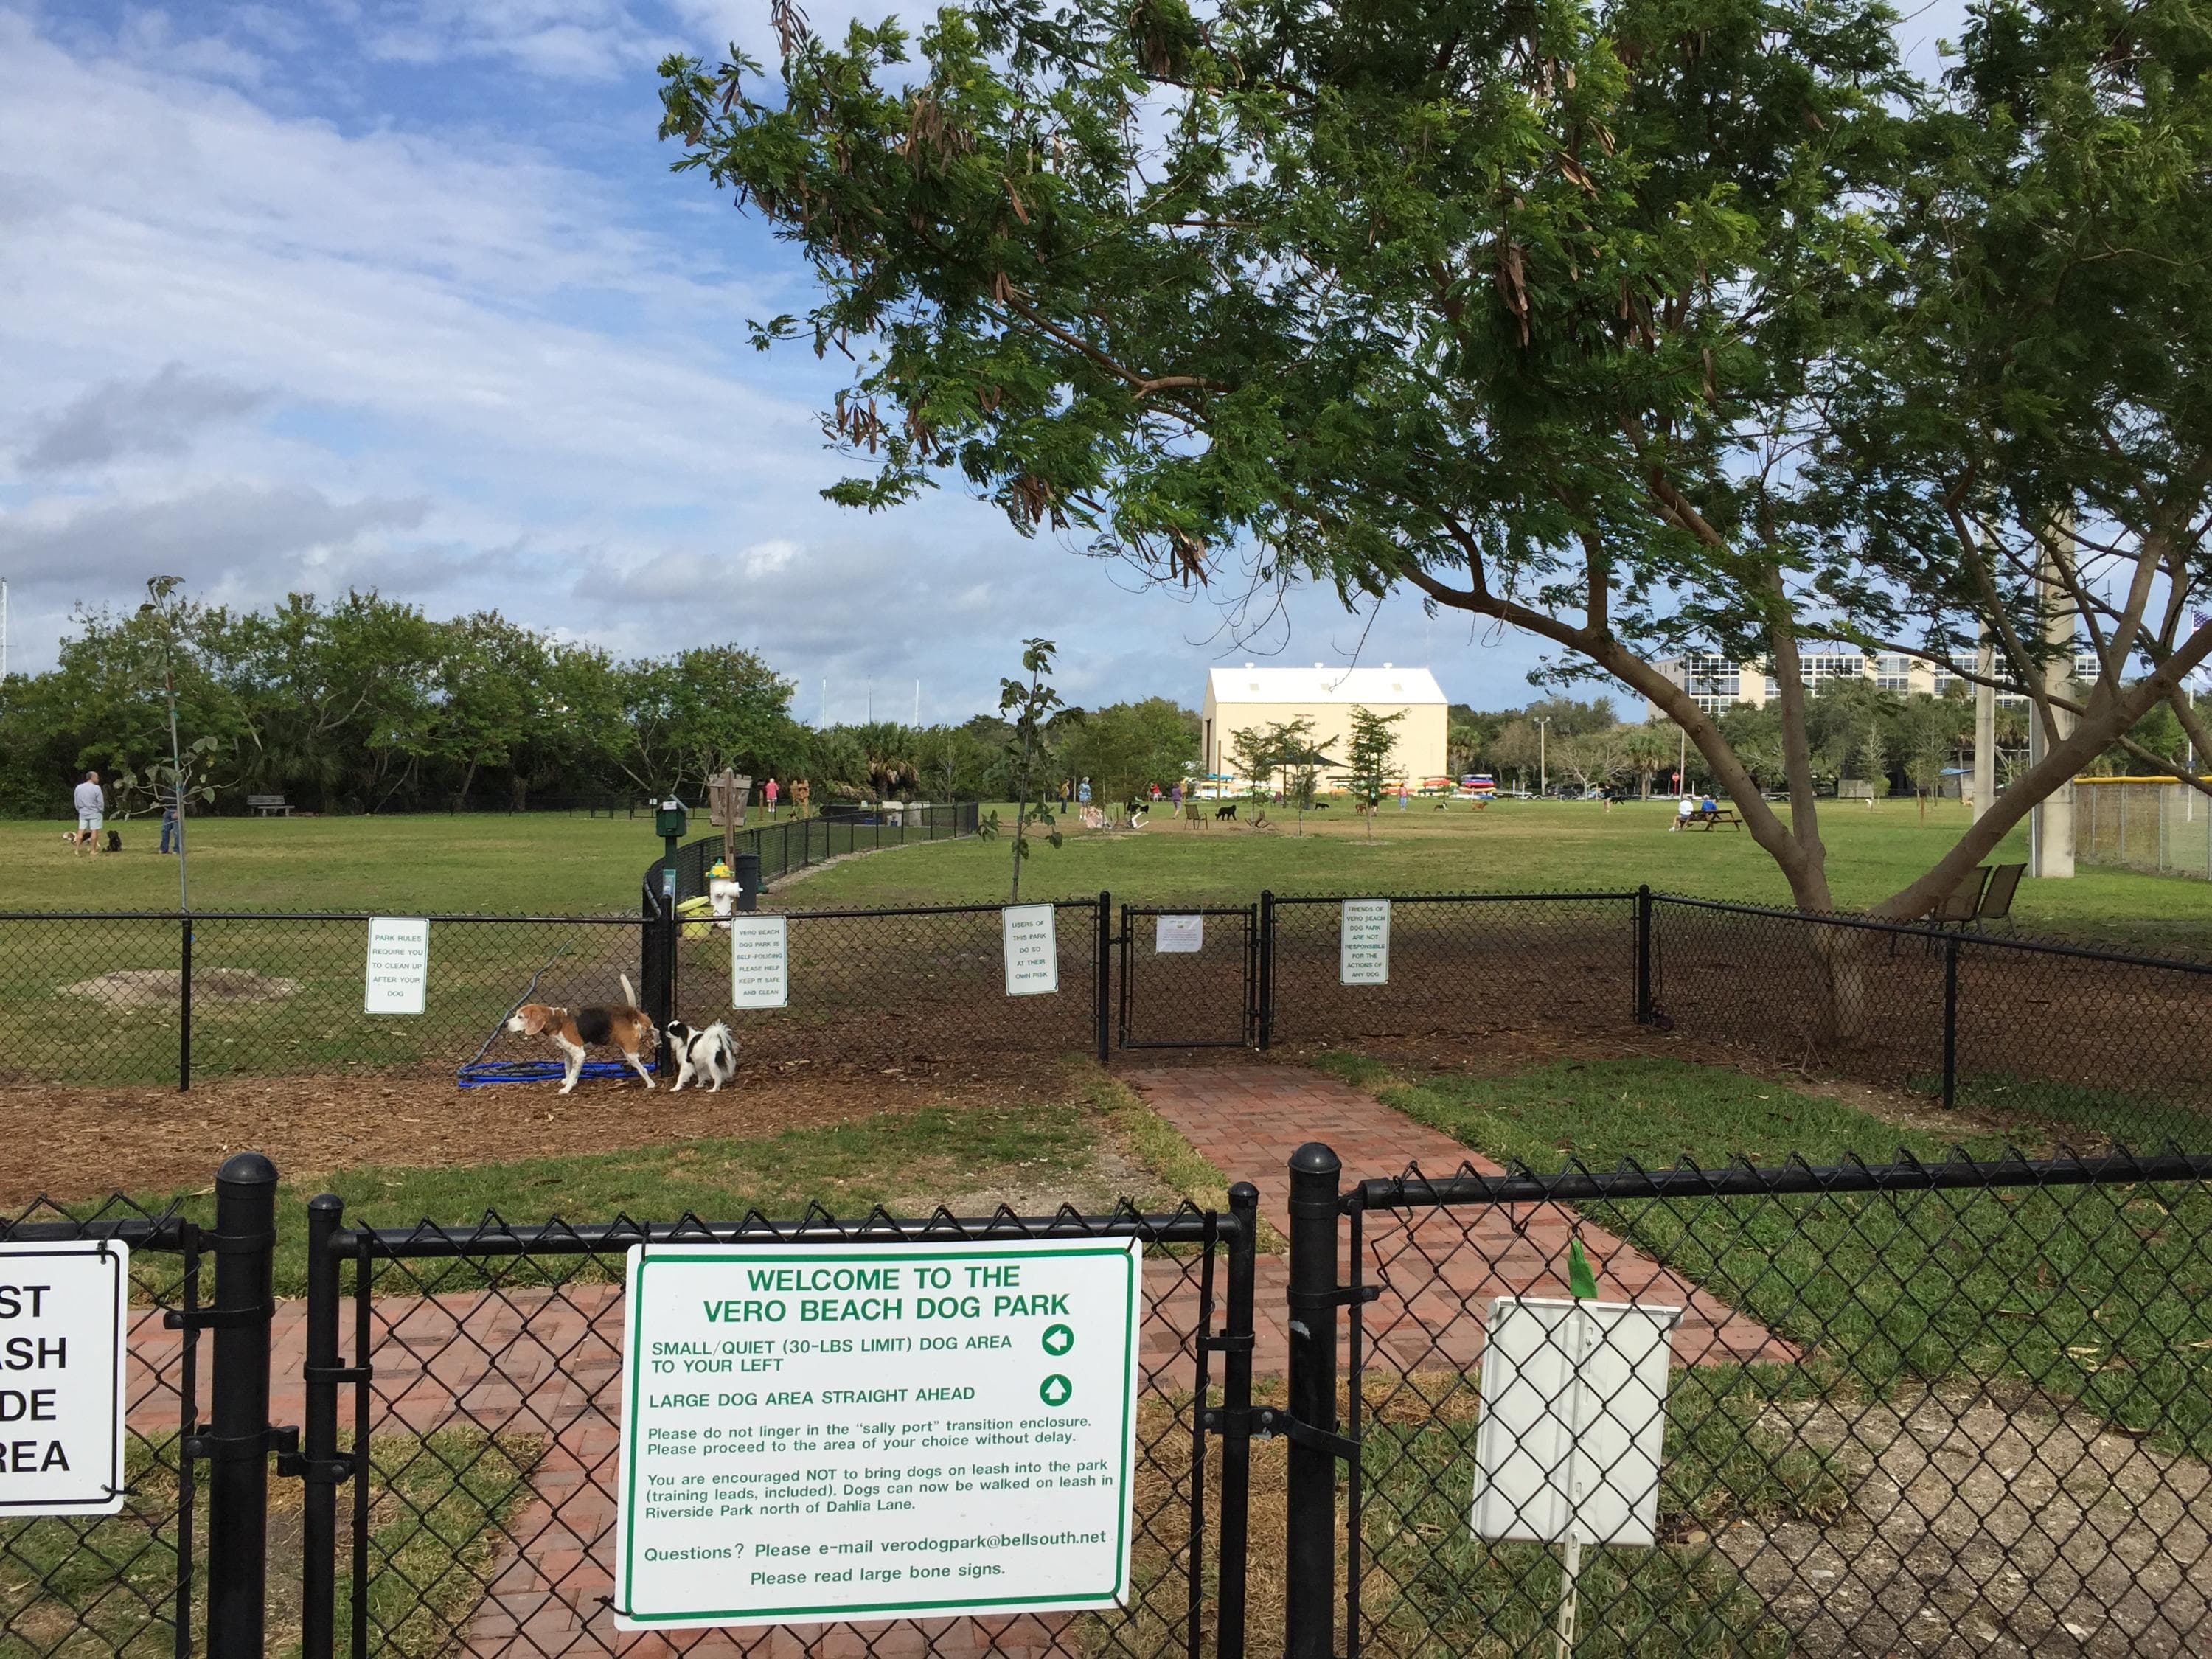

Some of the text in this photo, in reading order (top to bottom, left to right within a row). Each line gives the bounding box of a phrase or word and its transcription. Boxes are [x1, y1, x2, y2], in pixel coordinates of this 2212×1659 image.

[747, 1265, 1020, 1291] WELCOME TO THE
[703, 1294, 1069, 1322] VERO BEACH DOG PARK
[652, 1335, 1012, 1355] SMALL/QUIET (30-LBS LIMIT) DOG AREA
[652, 1359, 784, 1373] TO YOUR LEFT
[650, 1387, 975, 1408] LARGE DOG AREA STRAIGHT AHEAD
[649, 1428, 697, 1439] Please
[703, 1427, 721, 1439] do
[729, 1427, 752, 1438] not
[760, 1426, 801, 1439] linger
[807, 1425, 818, 1435] in
[827, 1424, 849, 1435] the
[947, 1419, 1012, 1431] transition
[1020, 1417, 1091, 1428] enclosure.
[648, 1431, 1075, 1456] Please proceed to the area of your choice without delay.
[648, 1459, 1107, 1485] You are encouraged NOT to bring dogs on leash into the park
[647, 1475, 1113, 1503] (training leads, included). Dogs can now be walked on leash in
[646, 1500, 915, 1518] Riverside Park north of Dahlia Lane.
[755, 1544, 810, 1557] Please
[819, 1540, 872, 1554] e-mail
[881, 1531, 1106, 1552] verodogpark@bellsouth.net
[751, 1563, 1004, 1585] Please read large bone signs.
